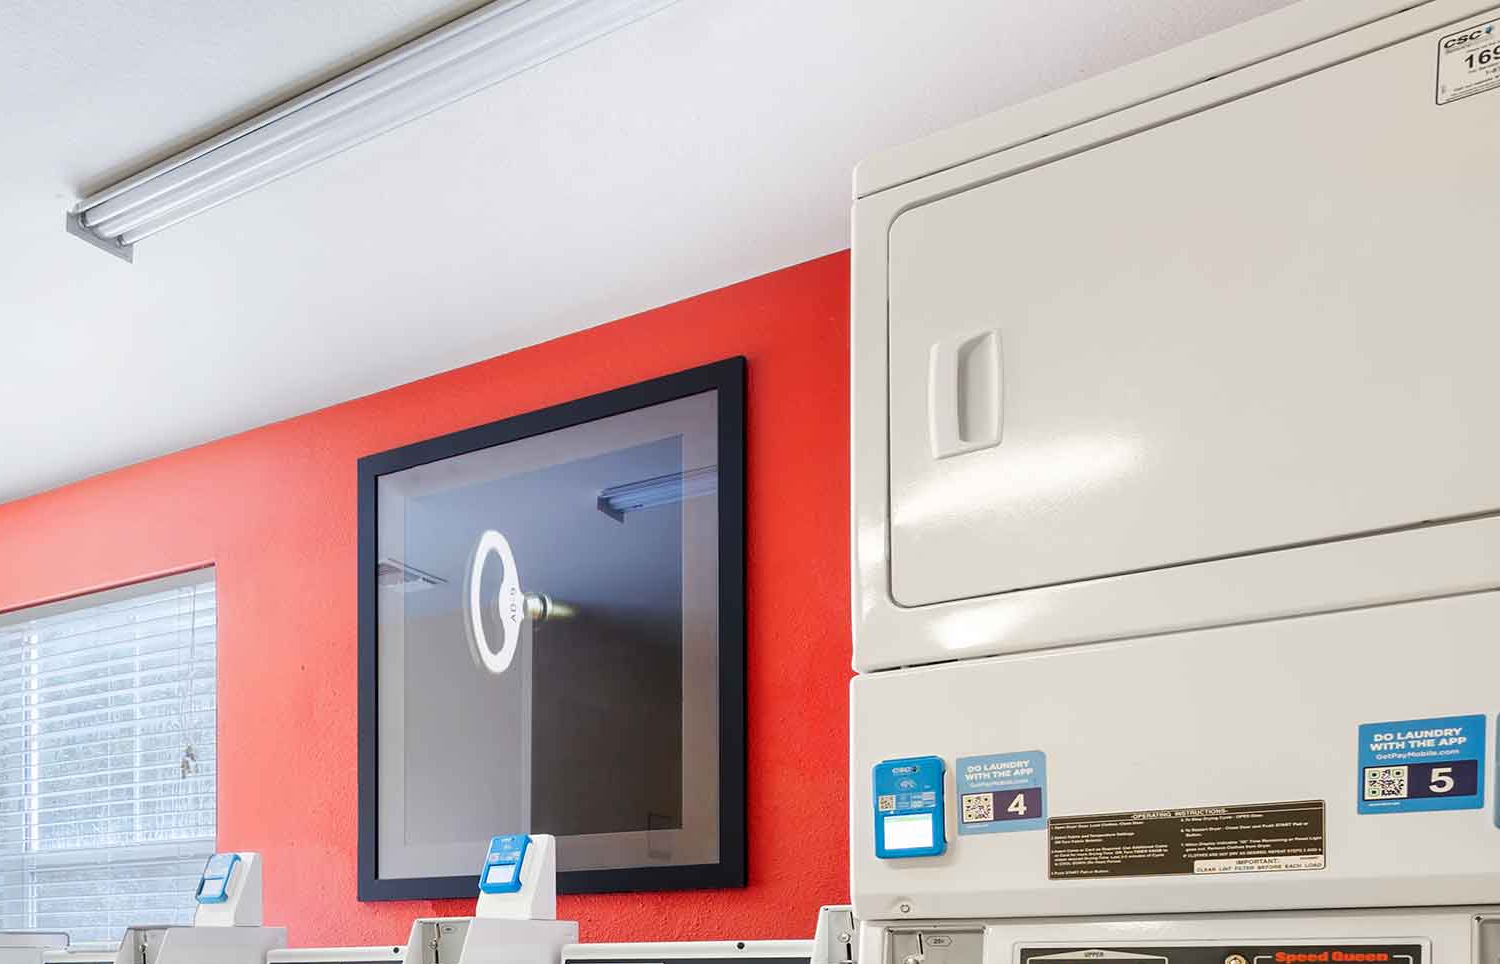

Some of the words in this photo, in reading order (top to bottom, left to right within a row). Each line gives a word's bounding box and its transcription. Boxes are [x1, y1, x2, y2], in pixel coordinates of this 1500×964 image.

[1443, 30, 1482, 49] CSC
[1373, 733, 1393, 742] DO
[1397, 727, 1462, 740] LAUNDRY
[1369, 741, 1405, 752] WITH
[1408, 739, 1436, 749] THE
[1438, 736, 1467, 746] APP
[964, 772, 990, 781] WITH
[1013, 767, 1034, 777] APP
[967, 765, 981, 773] DO
[983, 760, 1030, 771] LAUNDRY
[1428, 767, 1455, 793] 5
[1007, 793, 1028, 816] 4
[1275, 951, 1329, 964] Speed
[1331, 952, 1389, 963] Queen
